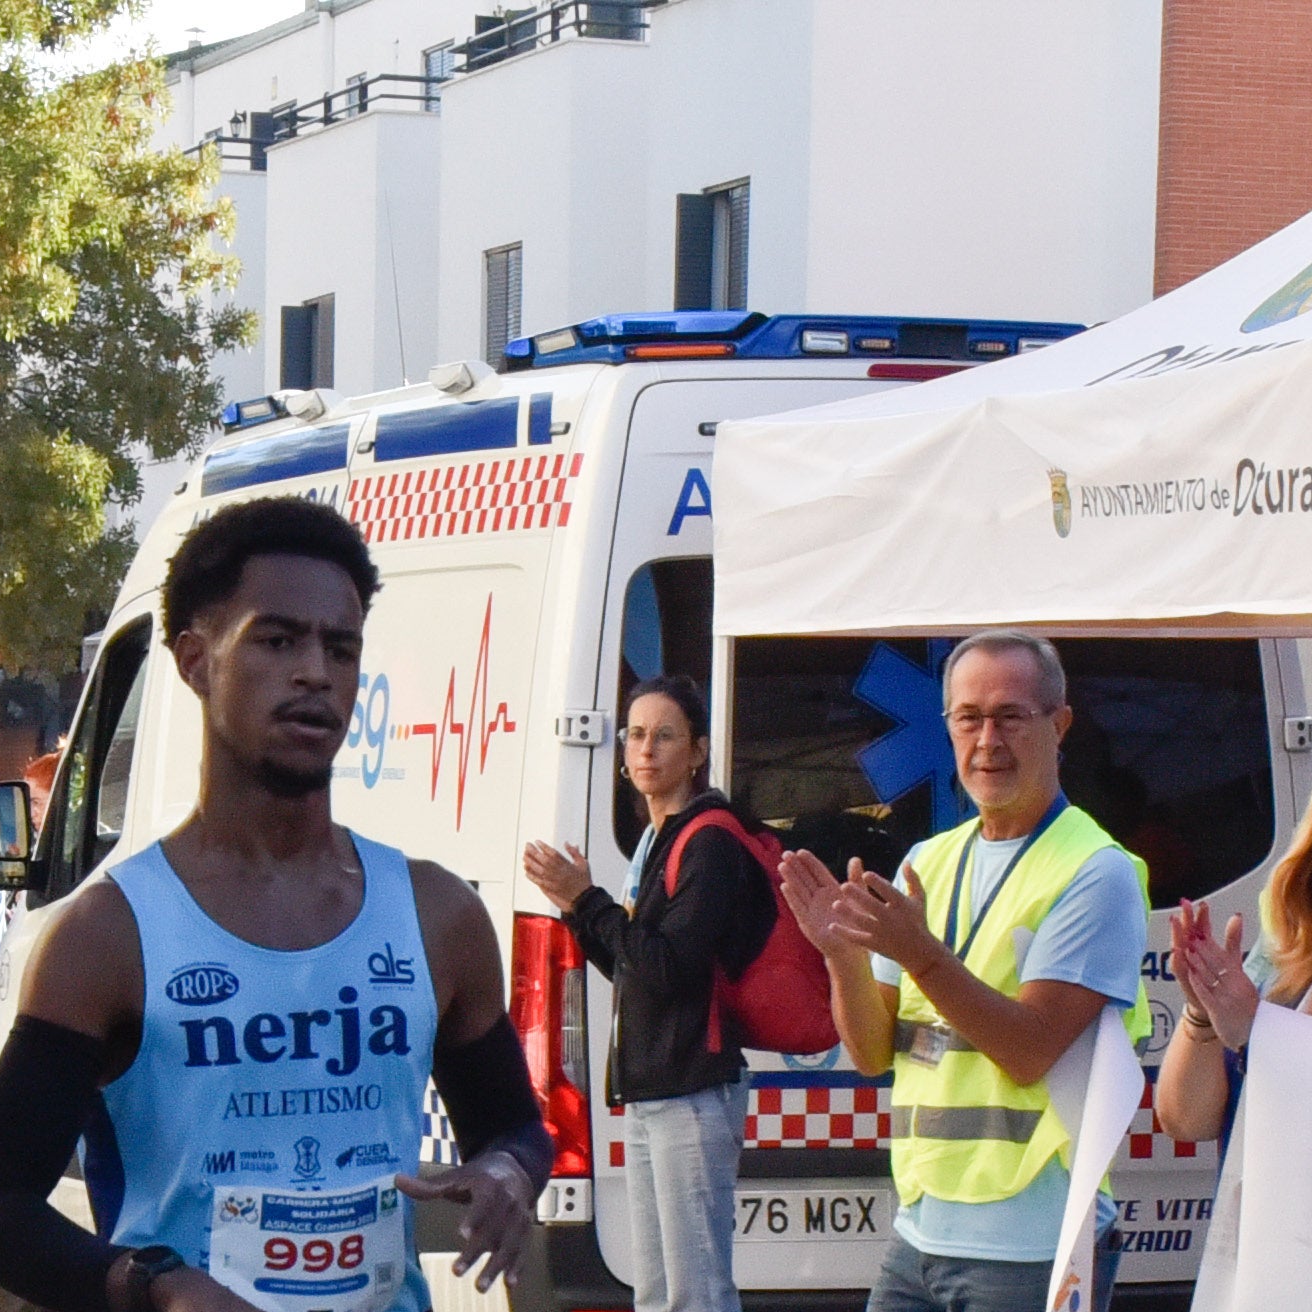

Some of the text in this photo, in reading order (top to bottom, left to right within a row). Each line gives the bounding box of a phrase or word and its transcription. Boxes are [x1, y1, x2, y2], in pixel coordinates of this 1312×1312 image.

[1081, 477, 1206, 518] AYUNTAMIENTO
[1210, 479, 1231, 509] de
[168, 967, 239, 1002] TROPS
[178, 985, 412, 1077] nerja
[223, 1084, 383, 1121] ATLETISMO
[264, 1219, 314, 1233] ASPACE
[734, 1196, 876, 1235] 76 MGX
[263, 1233, 366, 1273] 998
